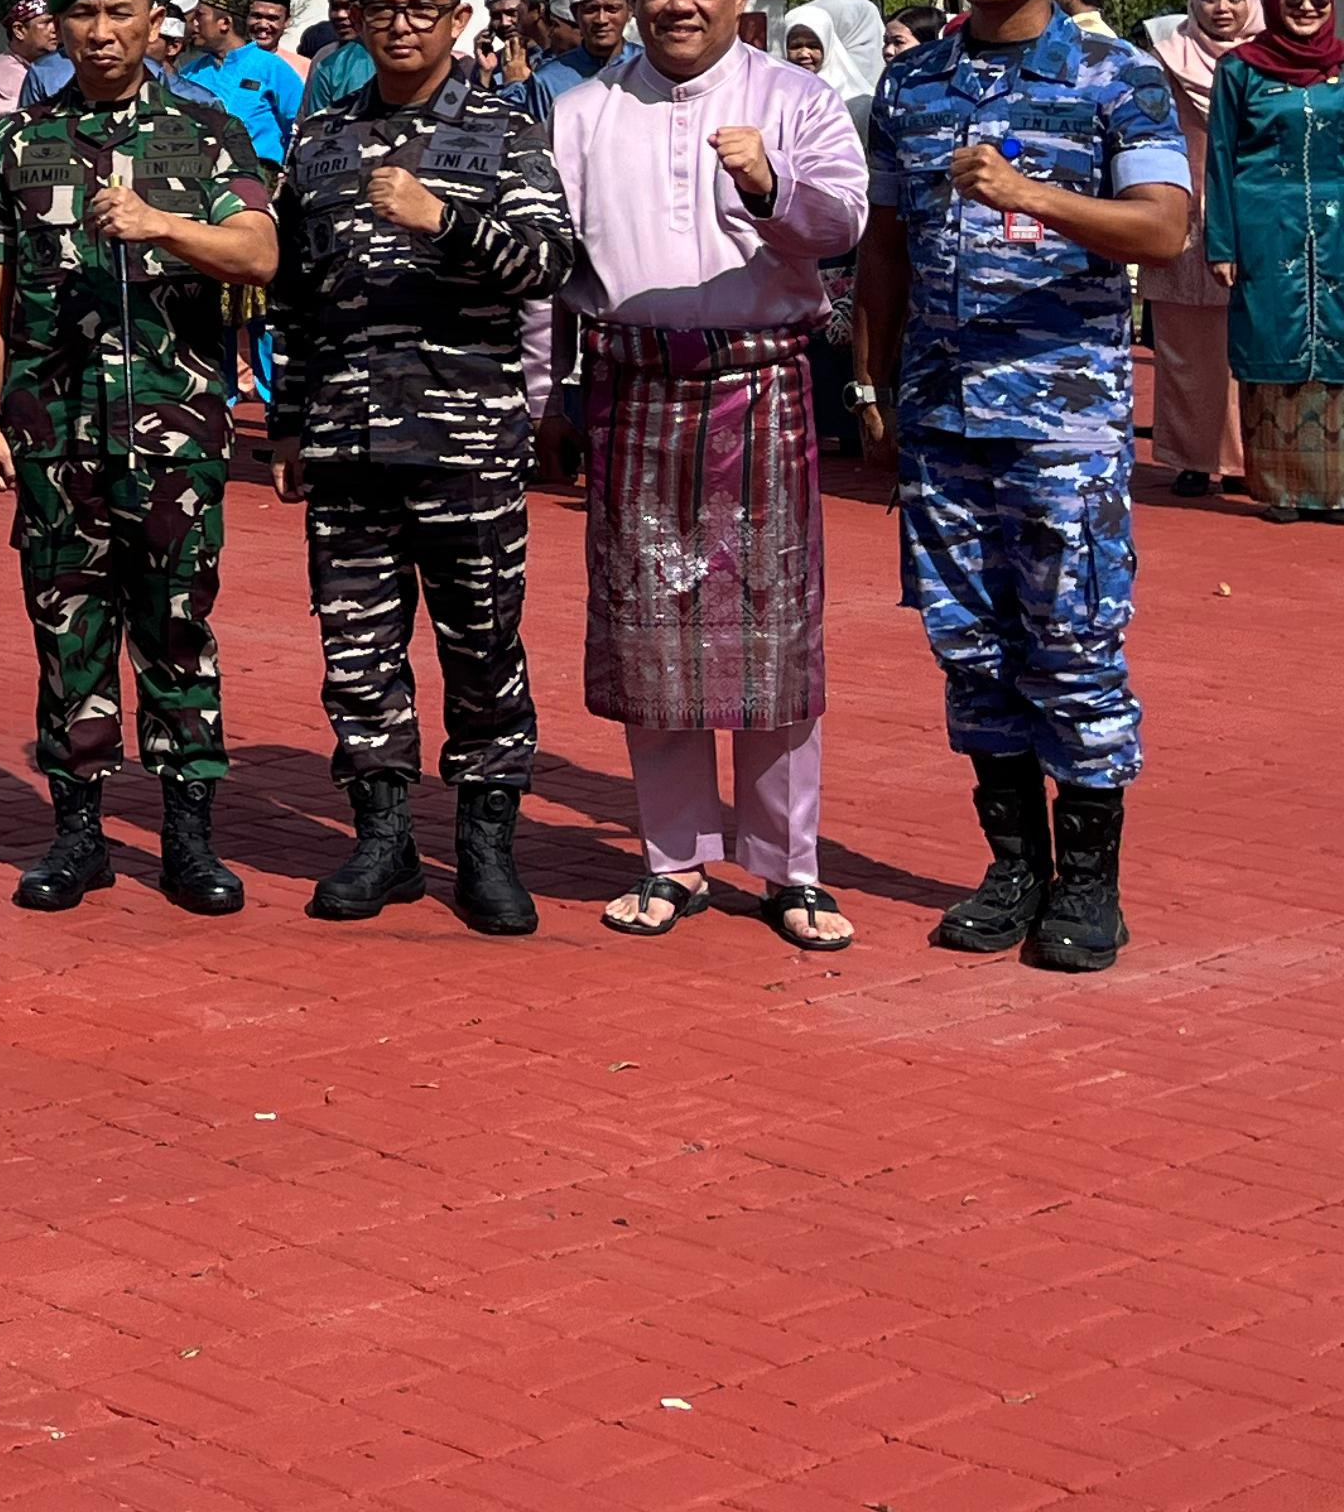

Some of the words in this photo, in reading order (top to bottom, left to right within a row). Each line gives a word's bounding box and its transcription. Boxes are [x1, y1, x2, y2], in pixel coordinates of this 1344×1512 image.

[1022, 117, 1052, 130] TNI
[434, 154, 461, 168] TNI
[467, 156, 489, 171] AL
[19, 167, 69, 184] HAMID
